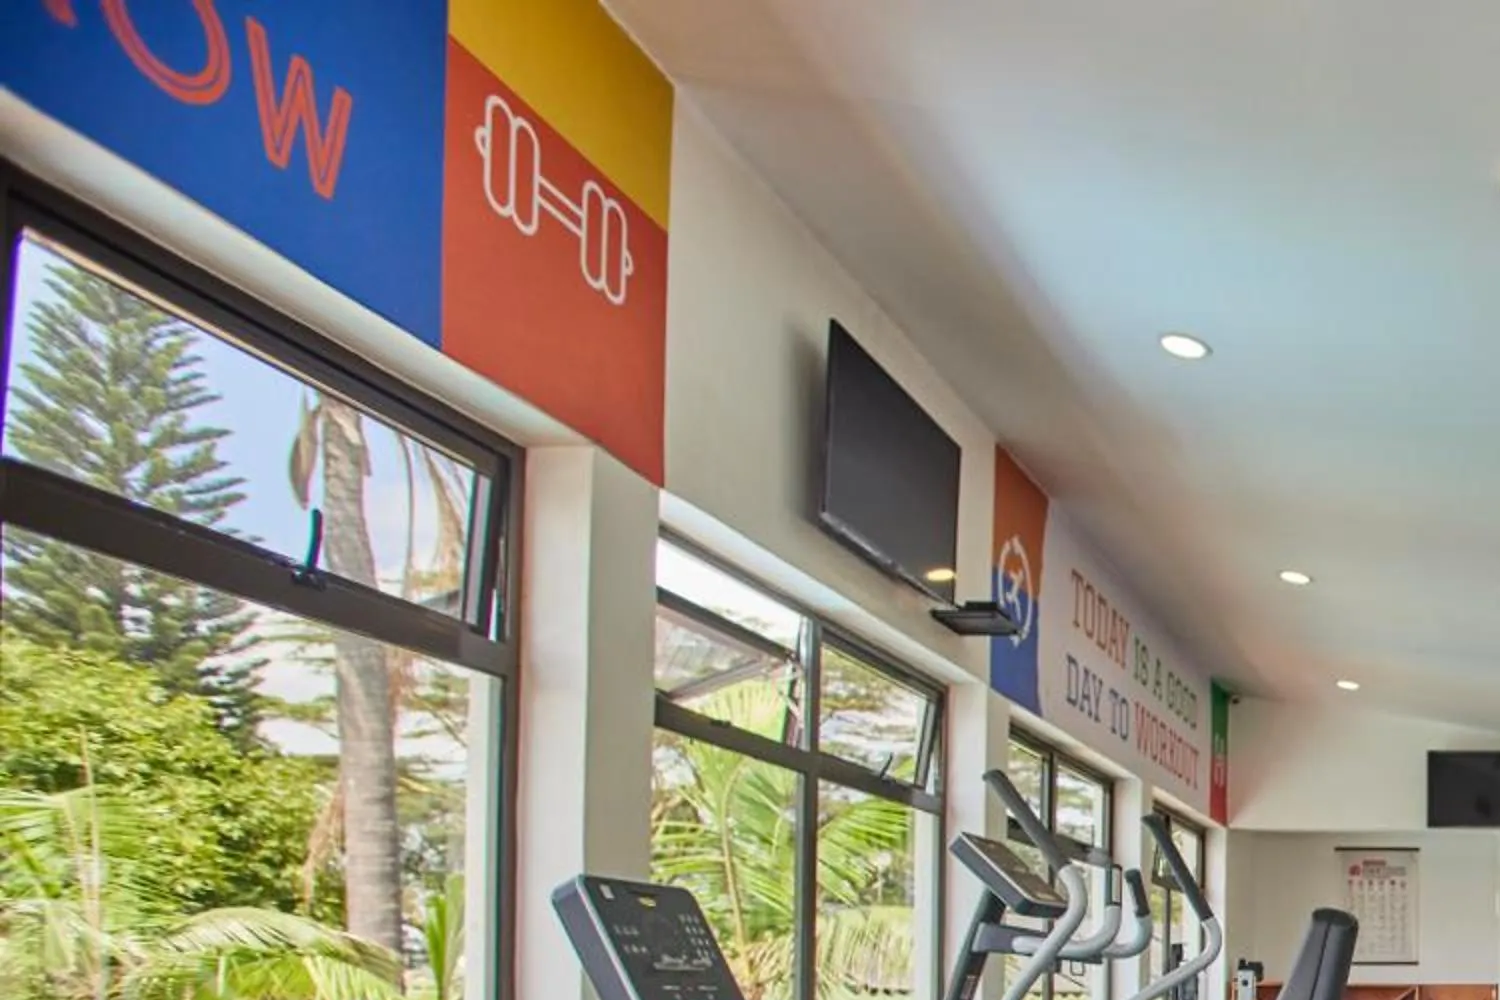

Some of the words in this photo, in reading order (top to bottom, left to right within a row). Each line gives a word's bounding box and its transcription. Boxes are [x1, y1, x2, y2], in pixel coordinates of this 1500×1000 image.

[42, 0, 353, 201] OW
[1066, 652, 1103, 723] DAY
[1109, 687, 1130, 741] TO
[1134, 701, 1199, 790] WORKOUT
[1071, 568, 1130, 670] TODAY
[1134, 636, 1148, 687] IS
[1153, 657, 1163, 702] A
[1167, 671, 1197, 730] GOOD
